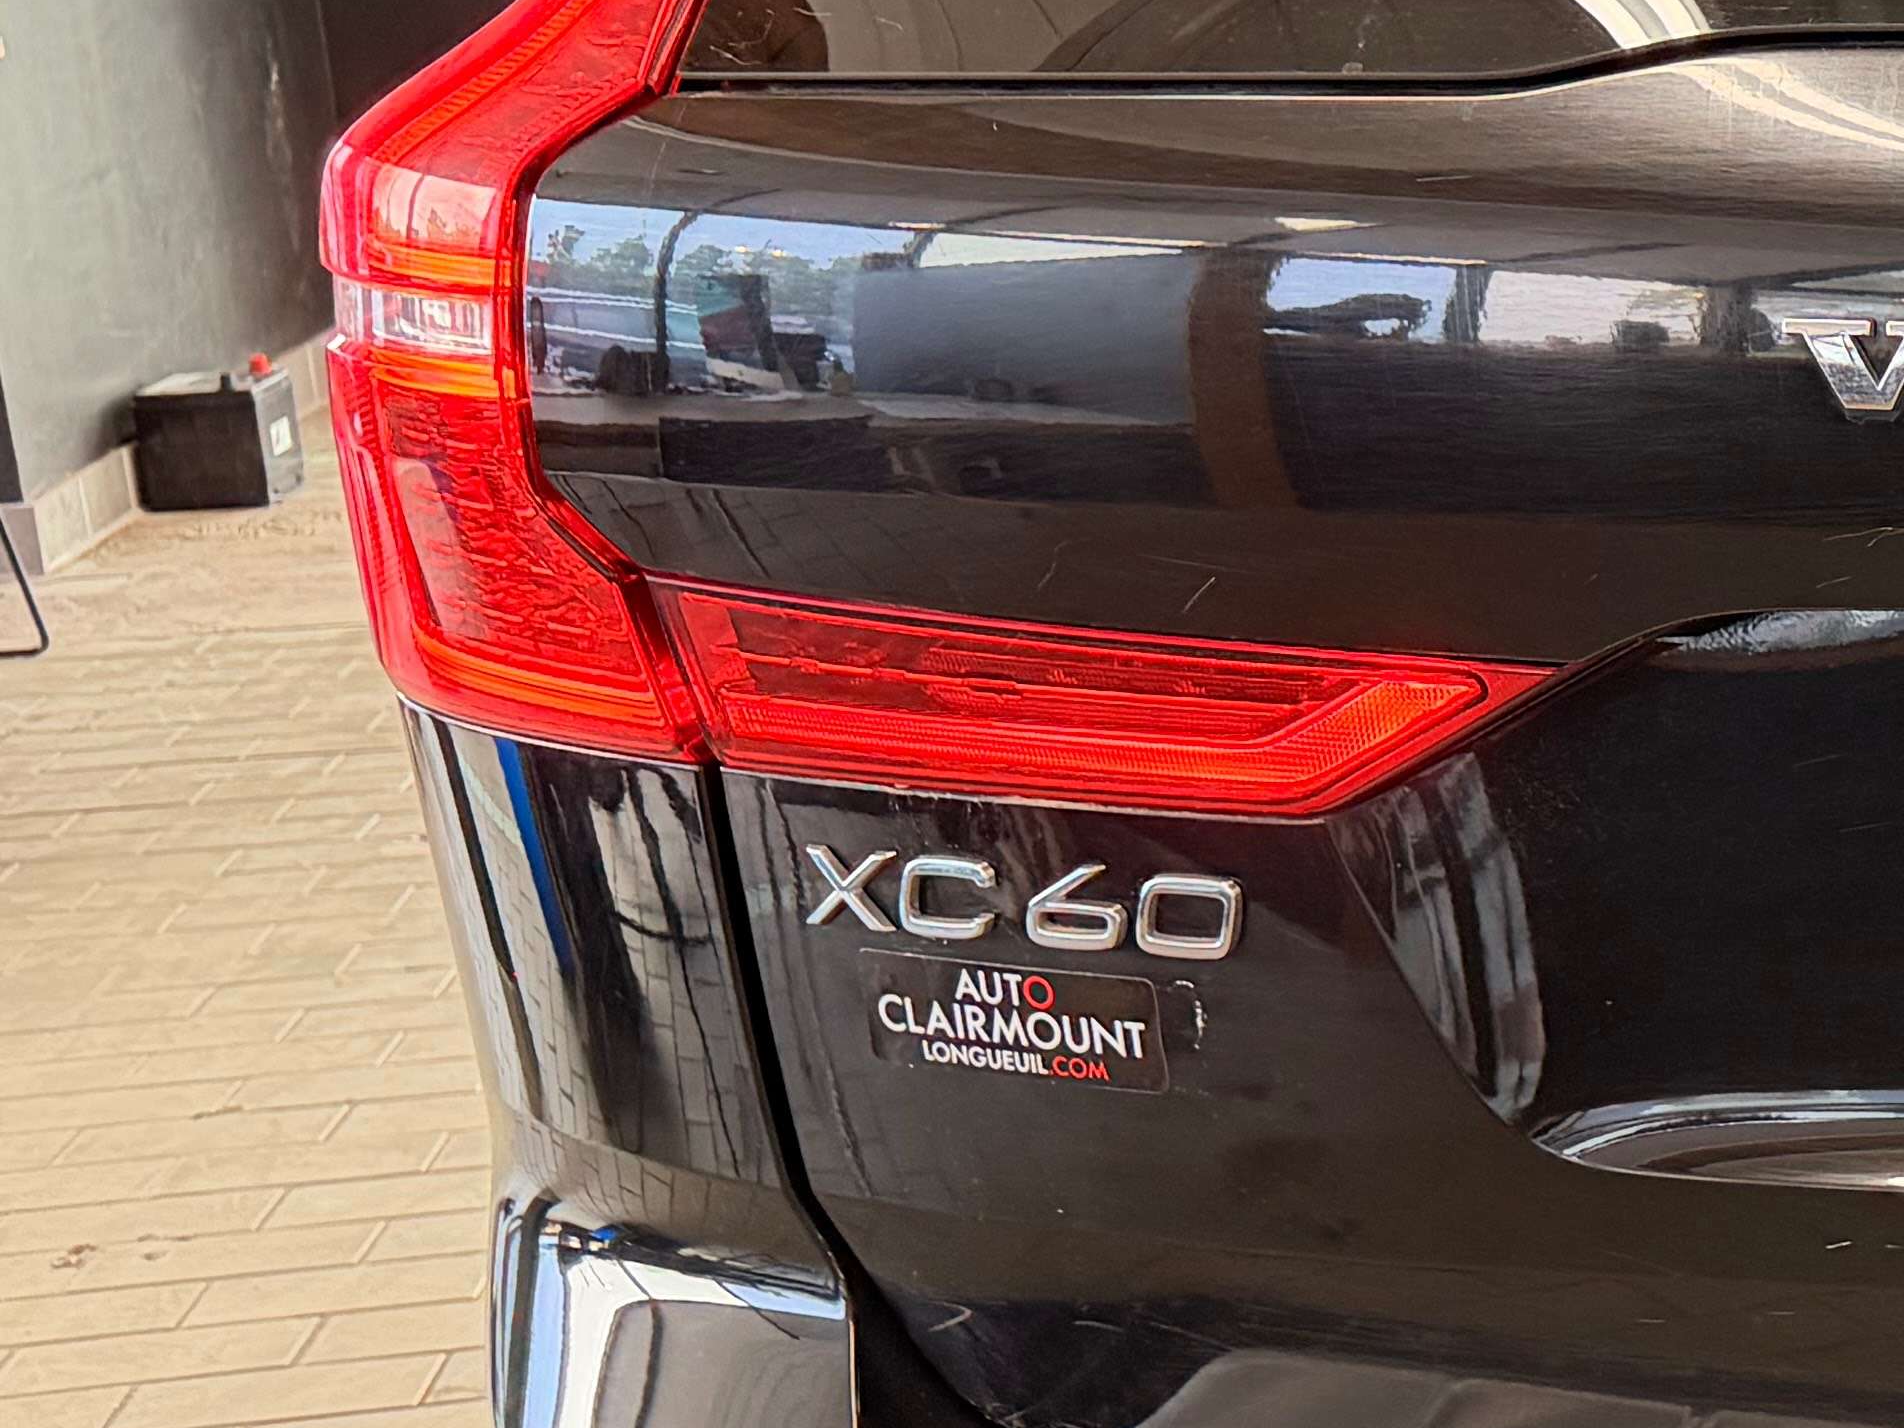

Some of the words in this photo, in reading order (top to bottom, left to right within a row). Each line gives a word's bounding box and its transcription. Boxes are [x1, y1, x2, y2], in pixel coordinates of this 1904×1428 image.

[955, 968, 1056, 1011] AUTO
[877, 992, 1146, 1059] CLAIRMOUNT
[921, 1038, 1110, 1082] LONGUEUIL.COM
